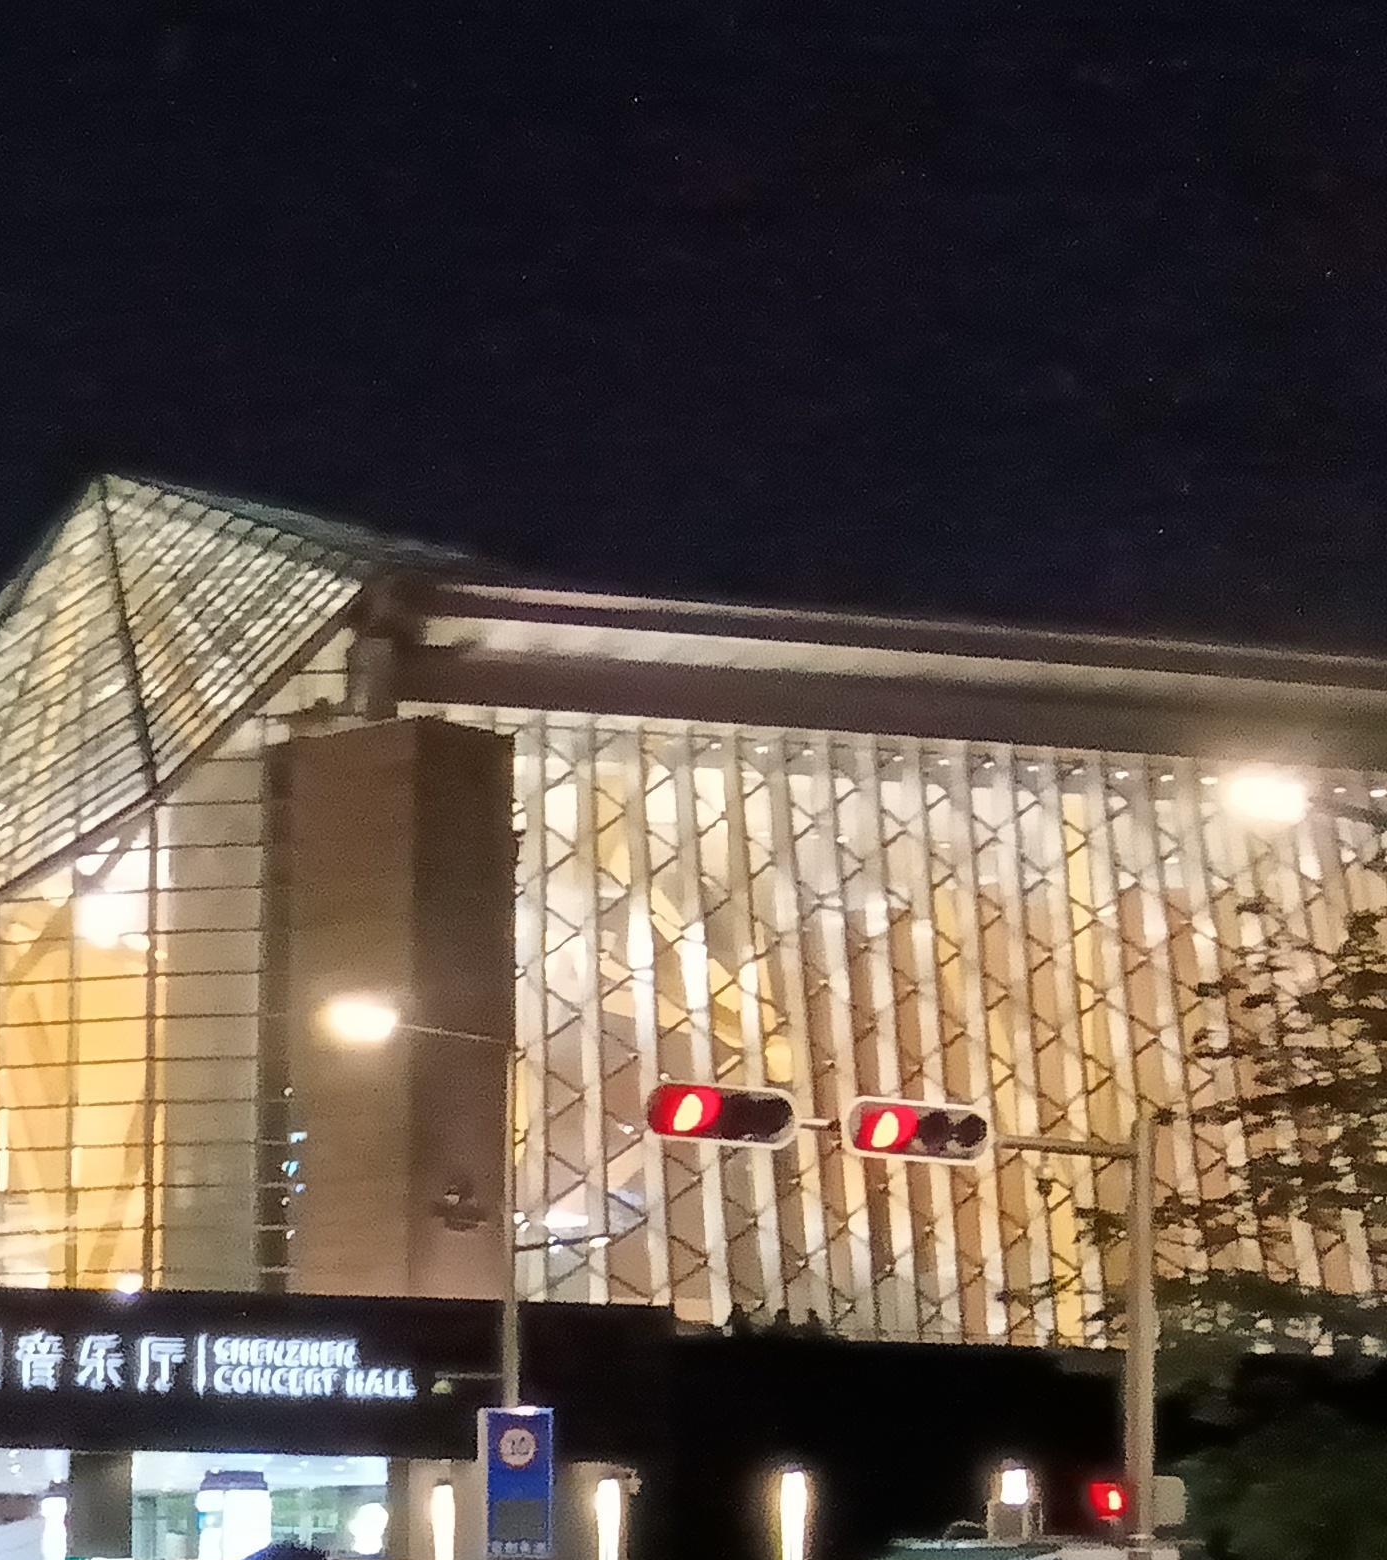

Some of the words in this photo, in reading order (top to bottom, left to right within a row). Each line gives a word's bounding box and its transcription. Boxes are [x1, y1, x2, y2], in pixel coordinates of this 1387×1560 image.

[213, 1336, 360, 1368] SHENZHEN
[213, 1366, 338, 1397] CONCERT
[345, 1368, 418, 1399] HALL
